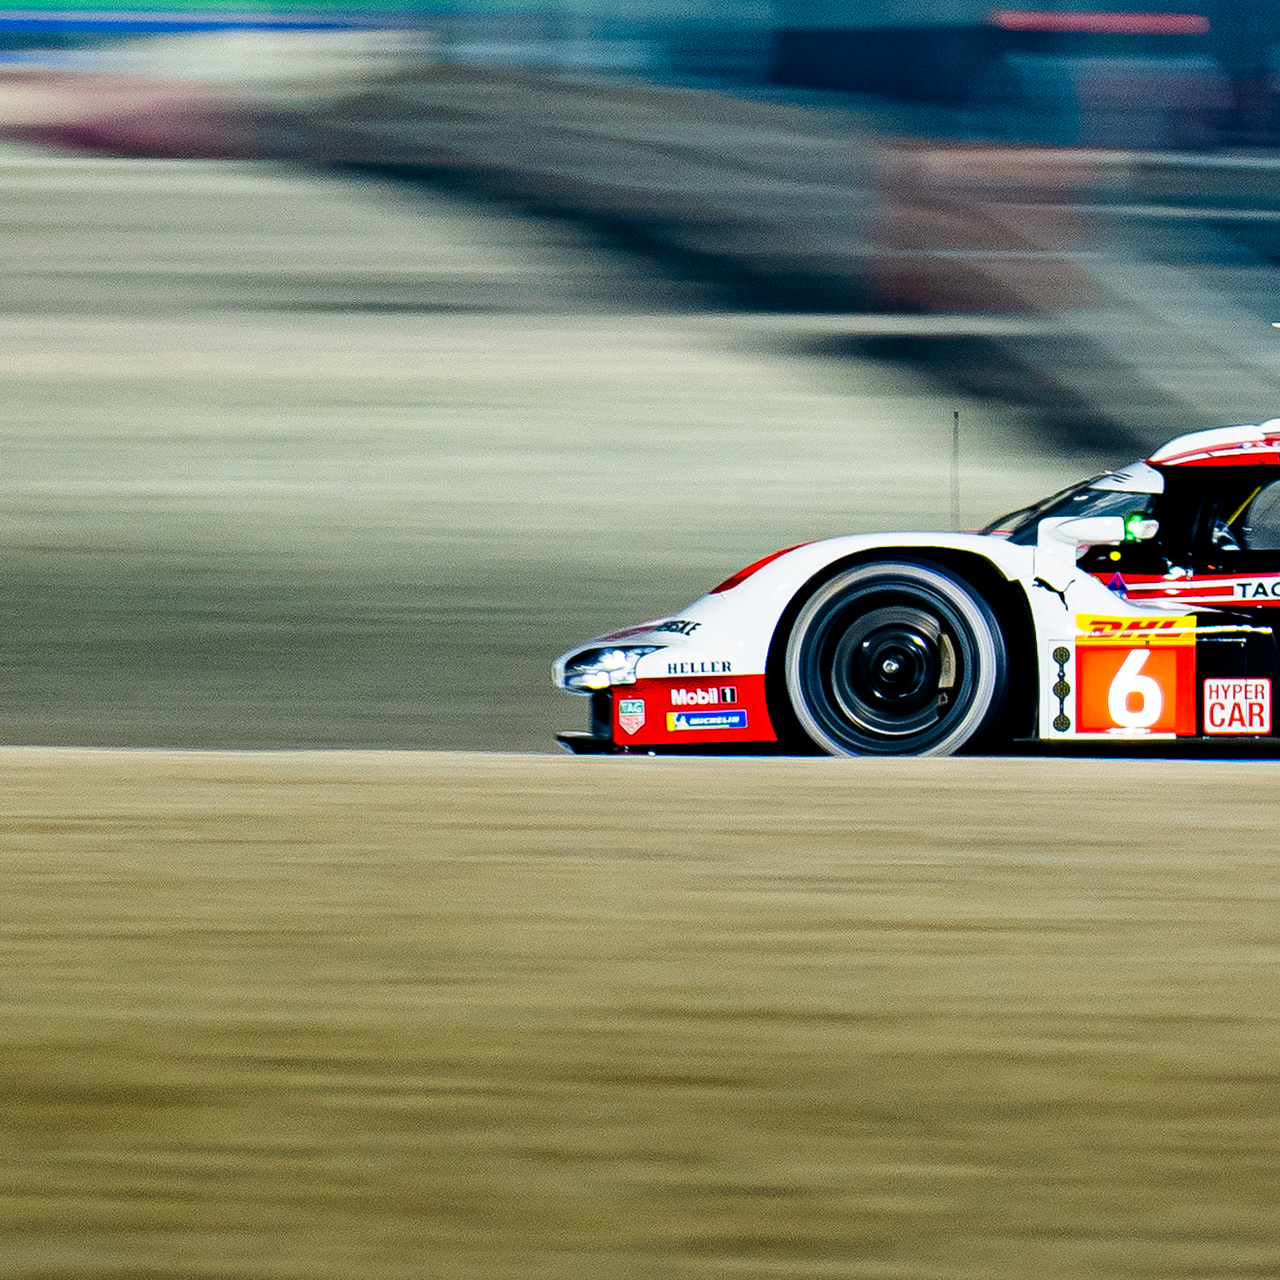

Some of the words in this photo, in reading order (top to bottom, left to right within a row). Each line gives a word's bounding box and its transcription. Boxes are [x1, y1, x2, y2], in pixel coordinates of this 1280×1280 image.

[1087, 620, 1182, 638] DHL
[667, 661, 732, 674] HELLER
[670, 687, 718, 705] Mobil
[1107, 648, 1163, 728] 6
[1208, 684, 1265, 700] HYPER
[689, 715, 740, 725] MICHELIN
[1208, 701, 1265, 728] CAR
